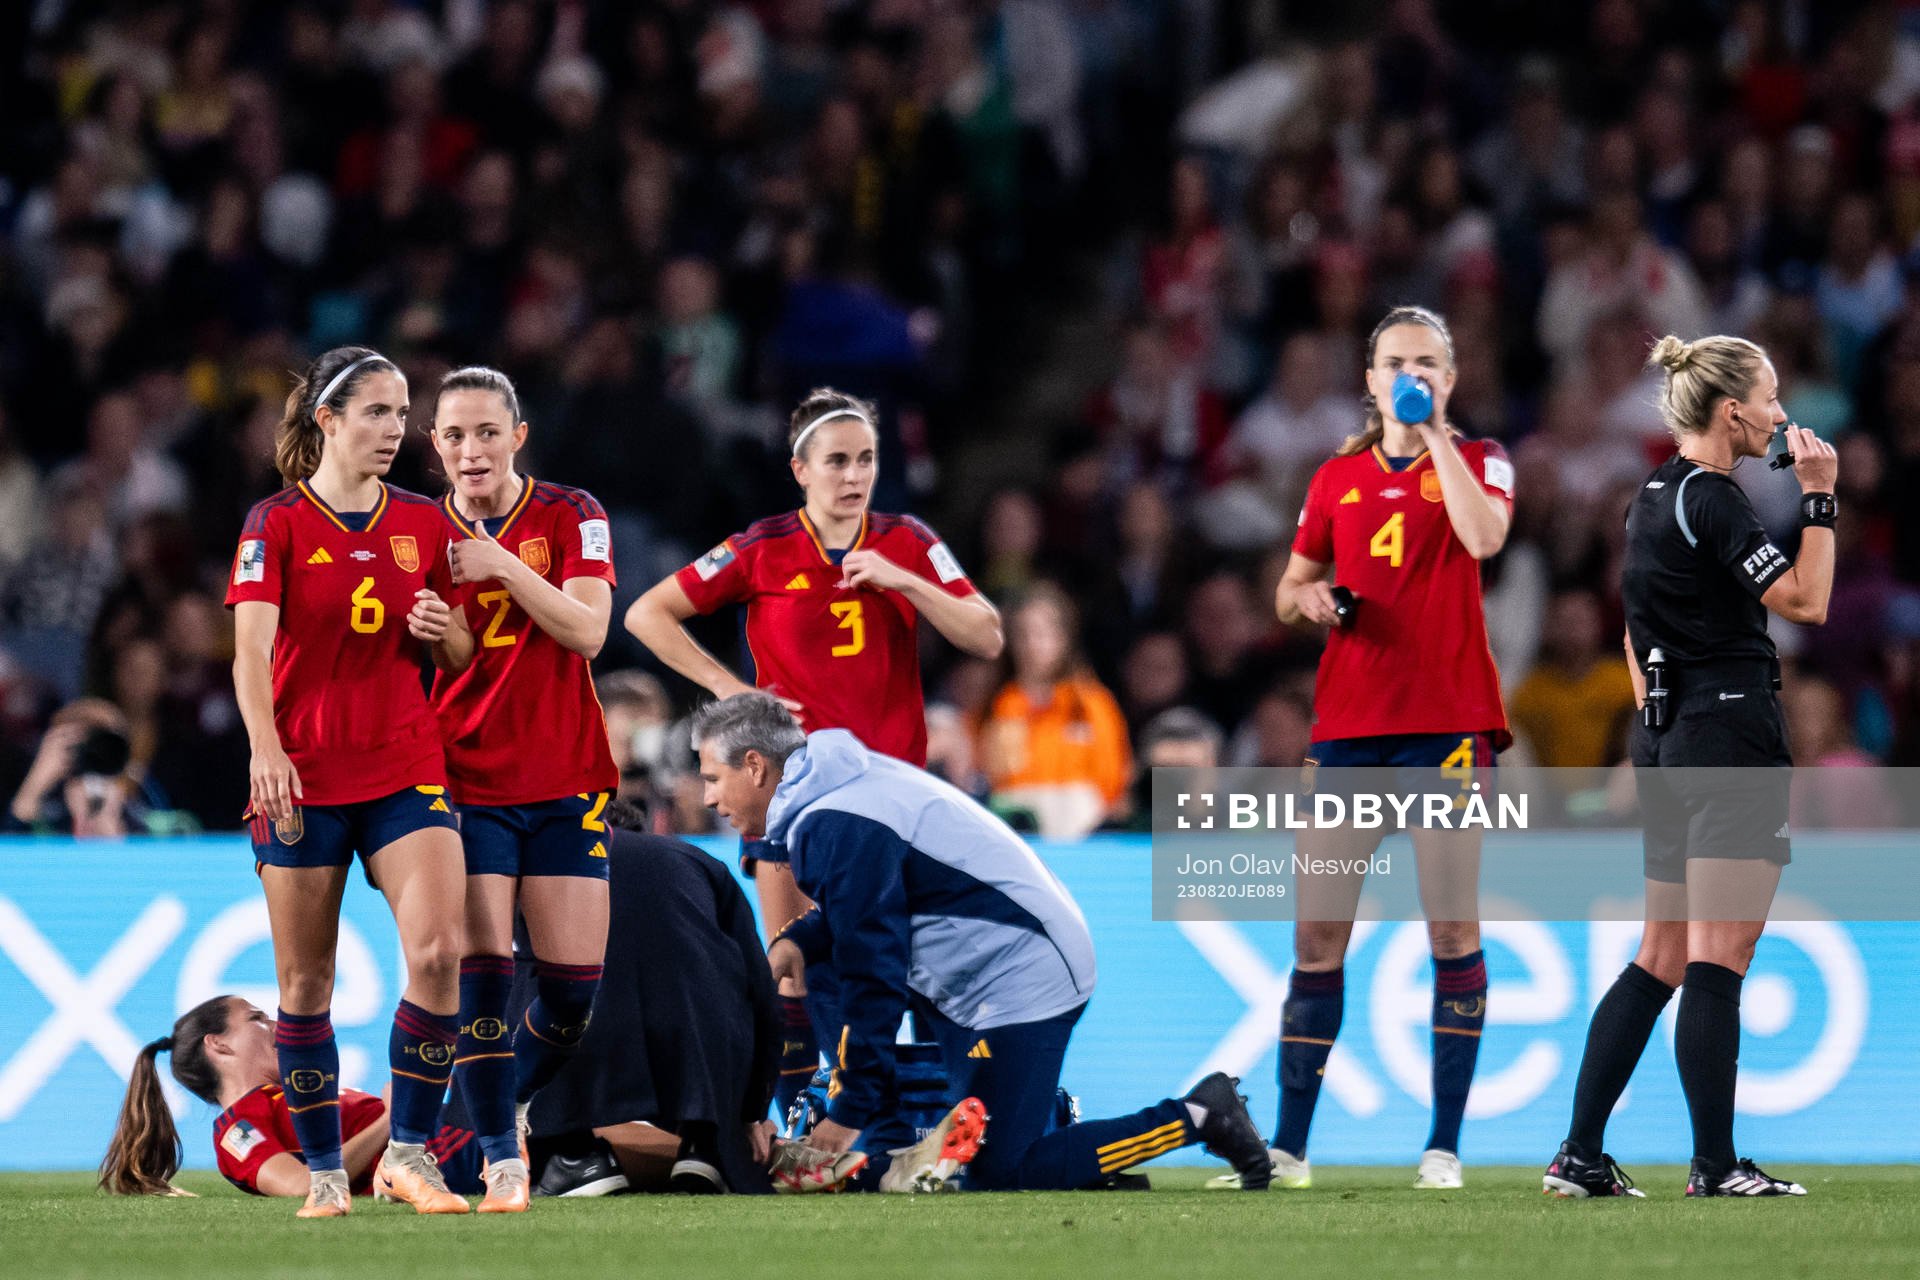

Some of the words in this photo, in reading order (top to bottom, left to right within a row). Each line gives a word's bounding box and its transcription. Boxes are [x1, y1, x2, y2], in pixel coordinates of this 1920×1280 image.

[1370, 512, 1405, 567] 4
[1743, 543, 1780, 575] FIFA
[1754, 564, 1775, 584] TEAM
[350, 576, 385, 634] 6
[477, 590, 516, 648] 2
[830, 601, 865, 657] 3
[1440, 737, 1473, 790] 4
[576, 792, 610, 833] 2
[0, 893, 405, 1122] xe
